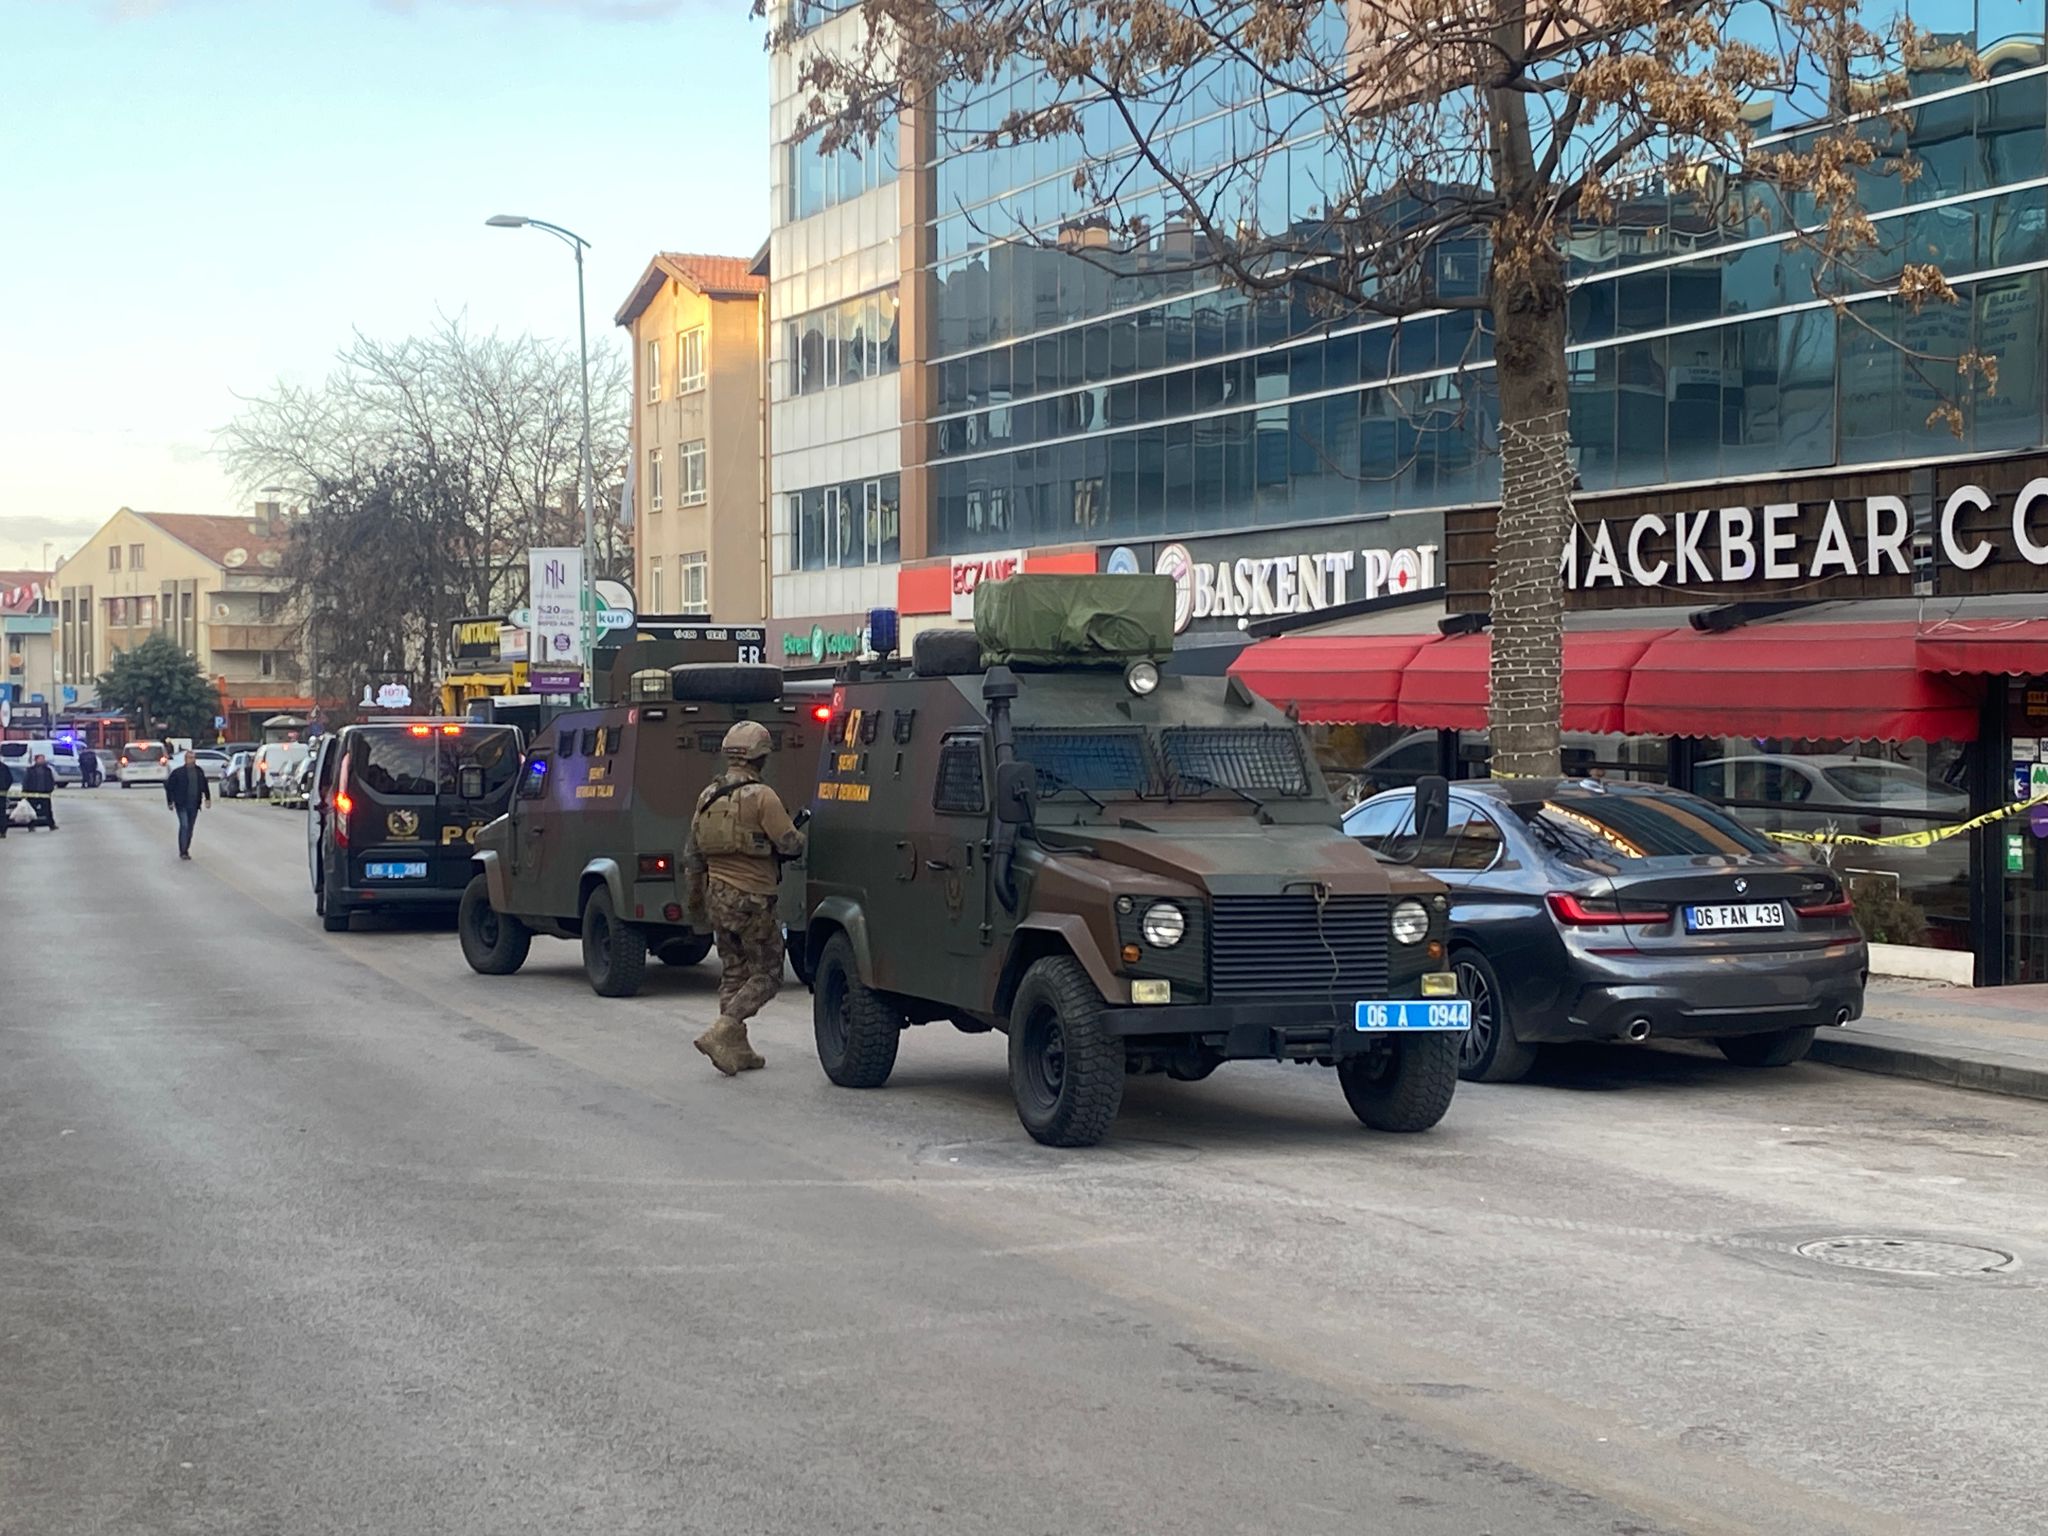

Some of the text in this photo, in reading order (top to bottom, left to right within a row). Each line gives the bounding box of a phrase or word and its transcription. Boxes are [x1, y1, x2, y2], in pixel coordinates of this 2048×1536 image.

[1191, 550, 1355, 631] BAŞKENT
[1696, 905, 1781, 926] 06 FAN 439
[1367, 1004, 1468, 1027] 06 A 0944
